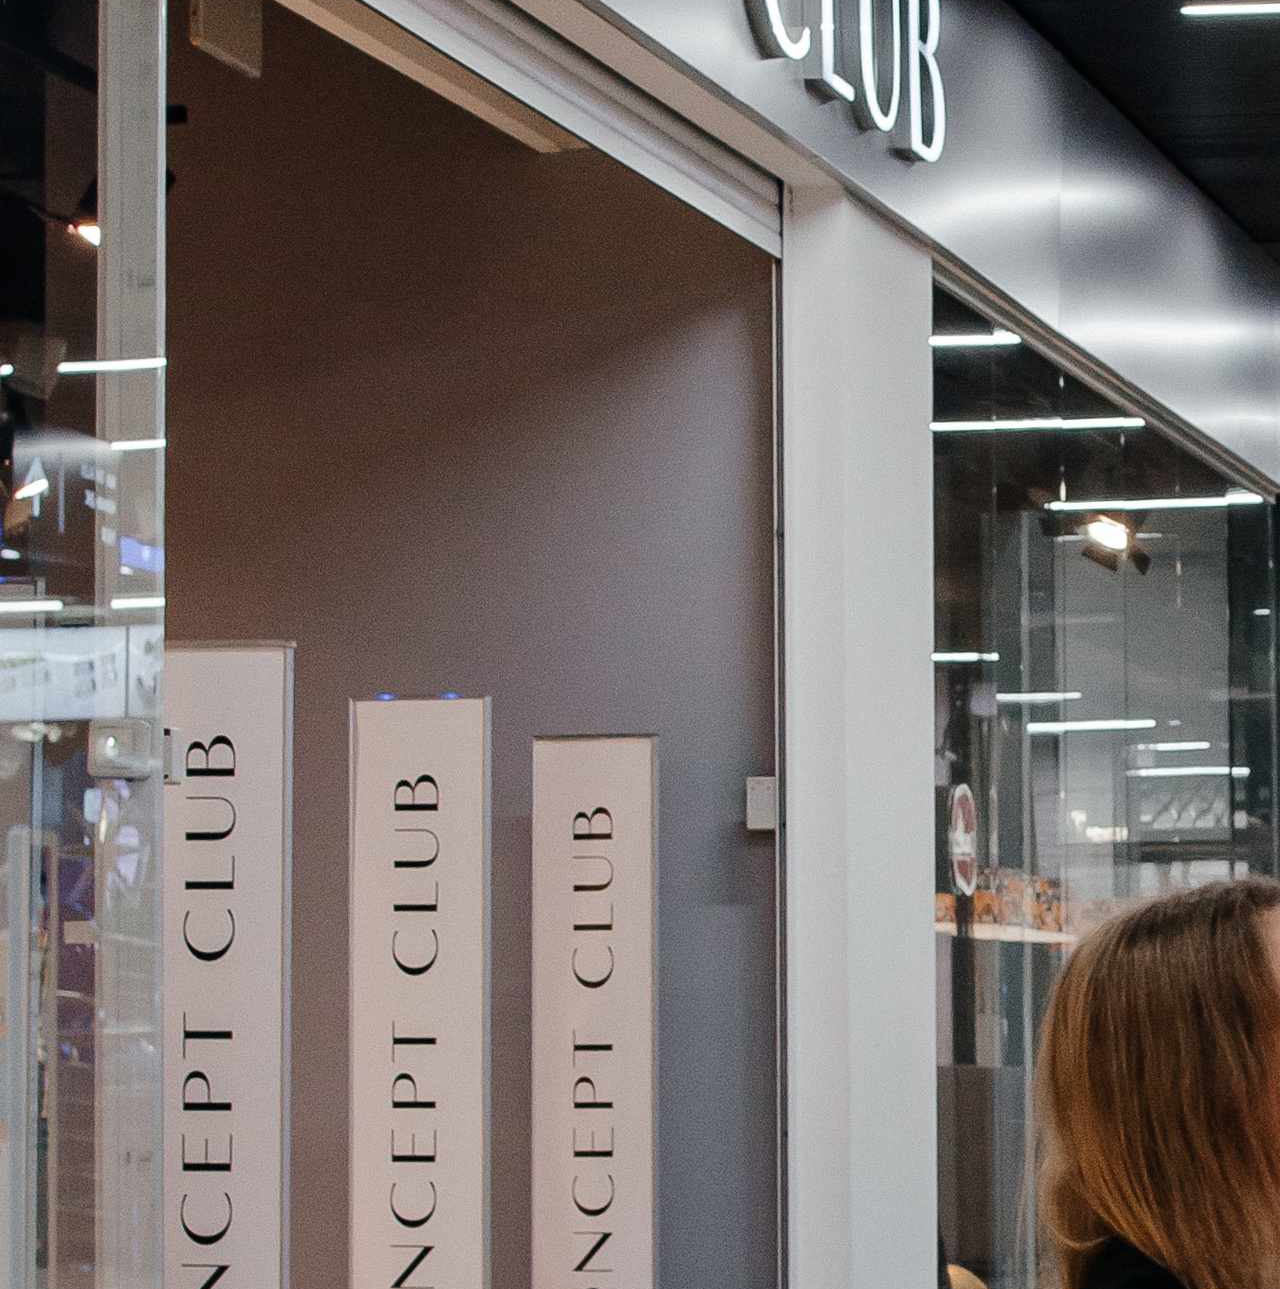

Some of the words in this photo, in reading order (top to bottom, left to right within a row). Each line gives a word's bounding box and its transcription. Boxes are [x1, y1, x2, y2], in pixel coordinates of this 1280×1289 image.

[183, 734, 236, 962] CLUB
[392, 773, 439, 977] CLUB
[572, 806, 614, 990] CLUB
